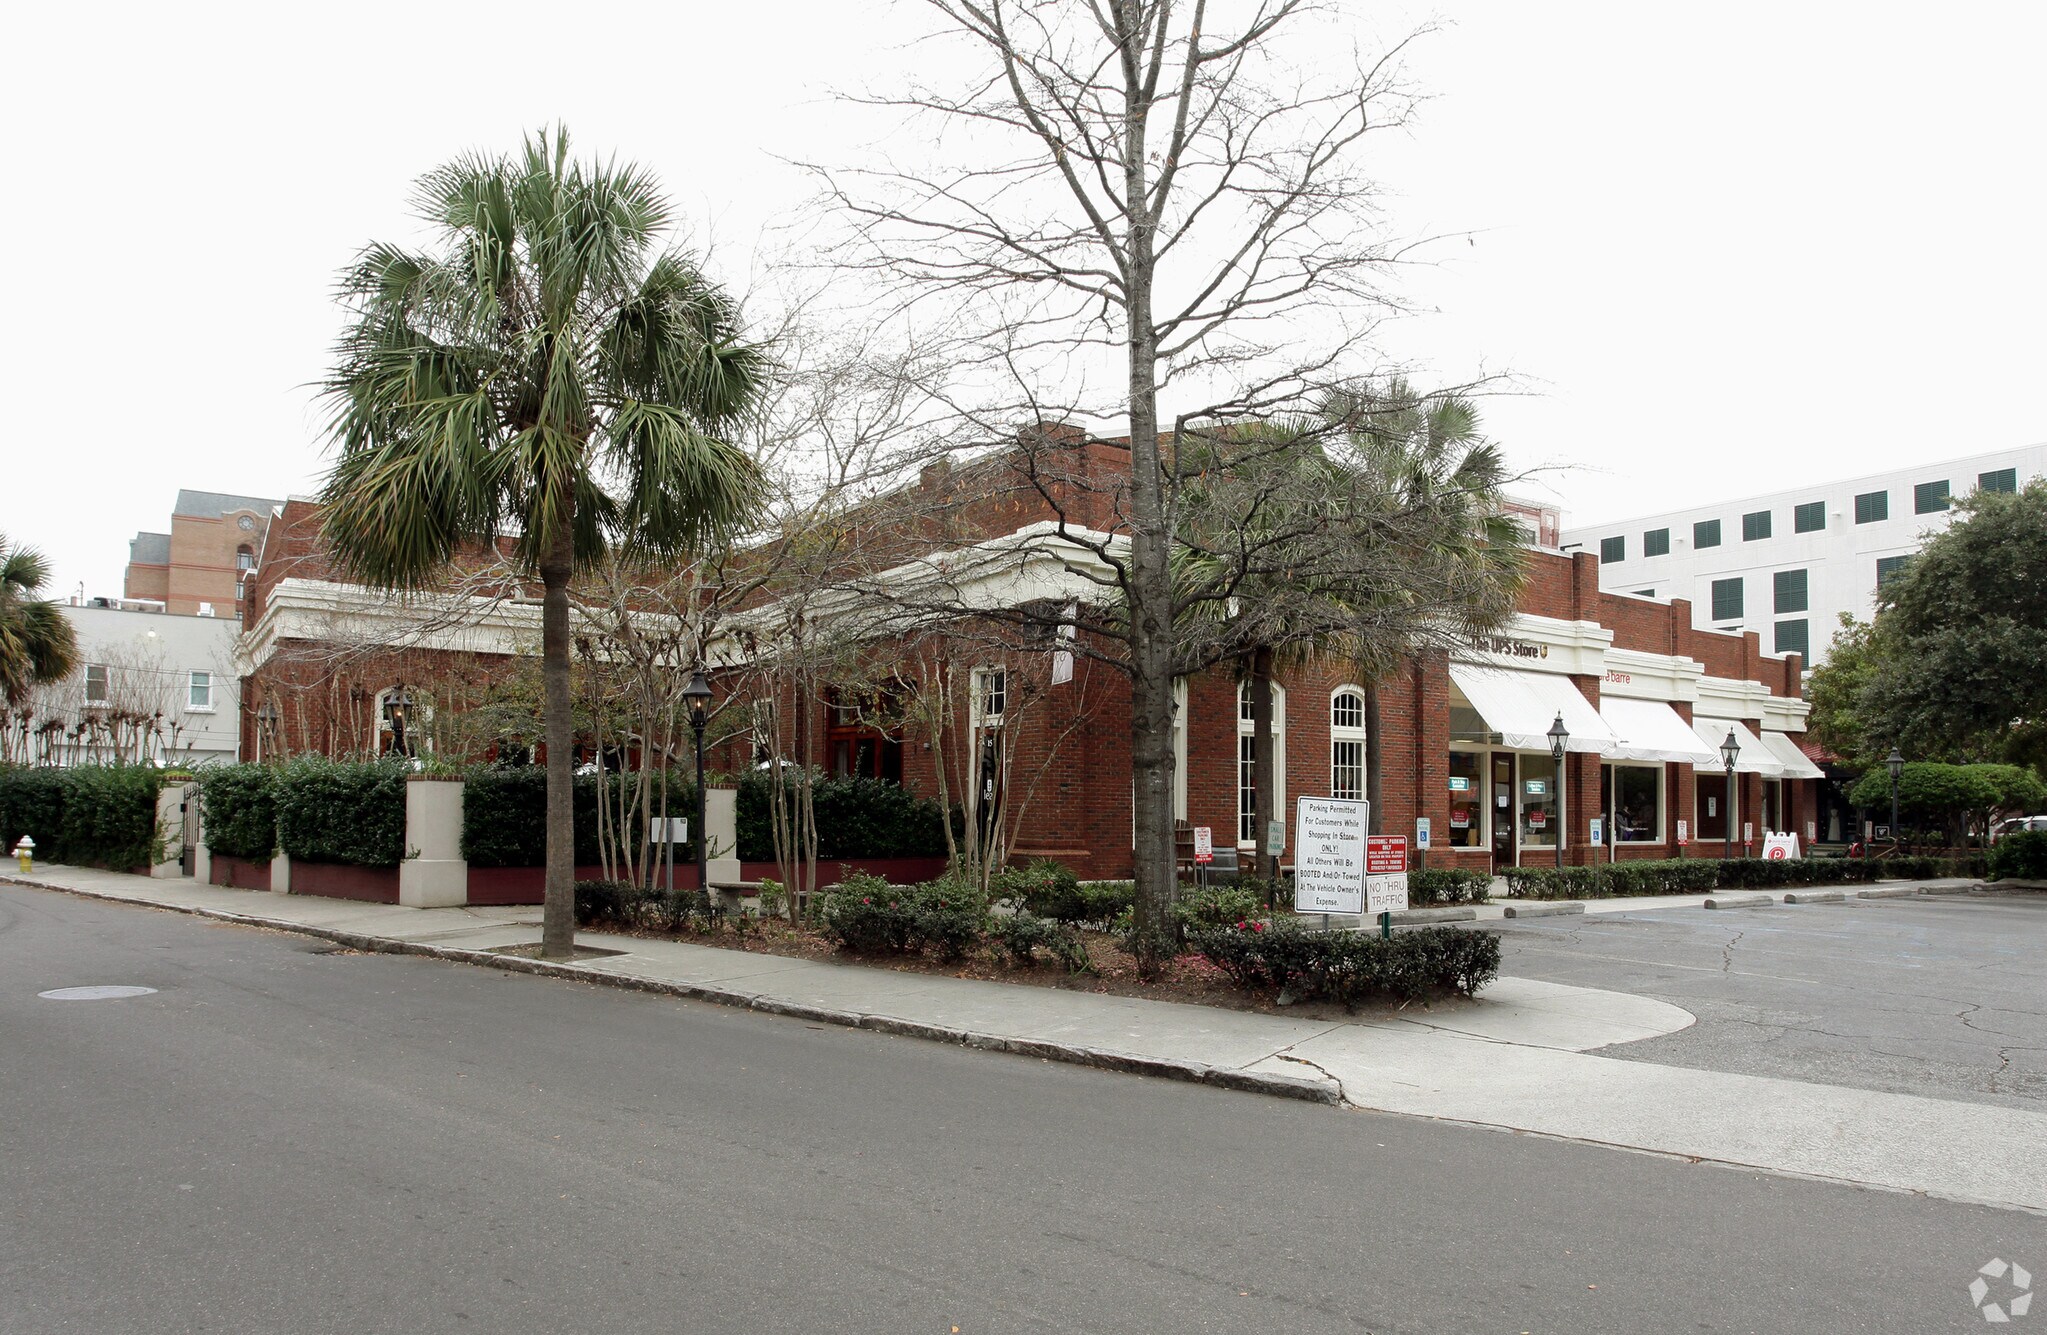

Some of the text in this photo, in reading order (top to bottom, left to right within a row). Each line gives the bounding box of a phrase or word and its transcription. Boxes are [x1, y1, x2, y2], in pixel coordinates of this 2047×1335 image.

[1471, 636, 1489, 652] The
[1492, 638, 1511, 655] UPS
[1513, 640, 1538, 658] Store
[1611, 670, 1630, 684] barre
[1310, 804, 1356, 814] Parking Permitted
[1315, 818, 1342, 826] Customers
[1308, 830, 1331, 840] Shopping
[1317, 884, 1335, 892] Vehicle
[1337, 885, 1359, 893] Owner's
[1370, 881, 1404, 892] NO THRU
[1316, 897, 1339, 906] Expense.
[1372, 894, 1404, 906] TRAFFIC
